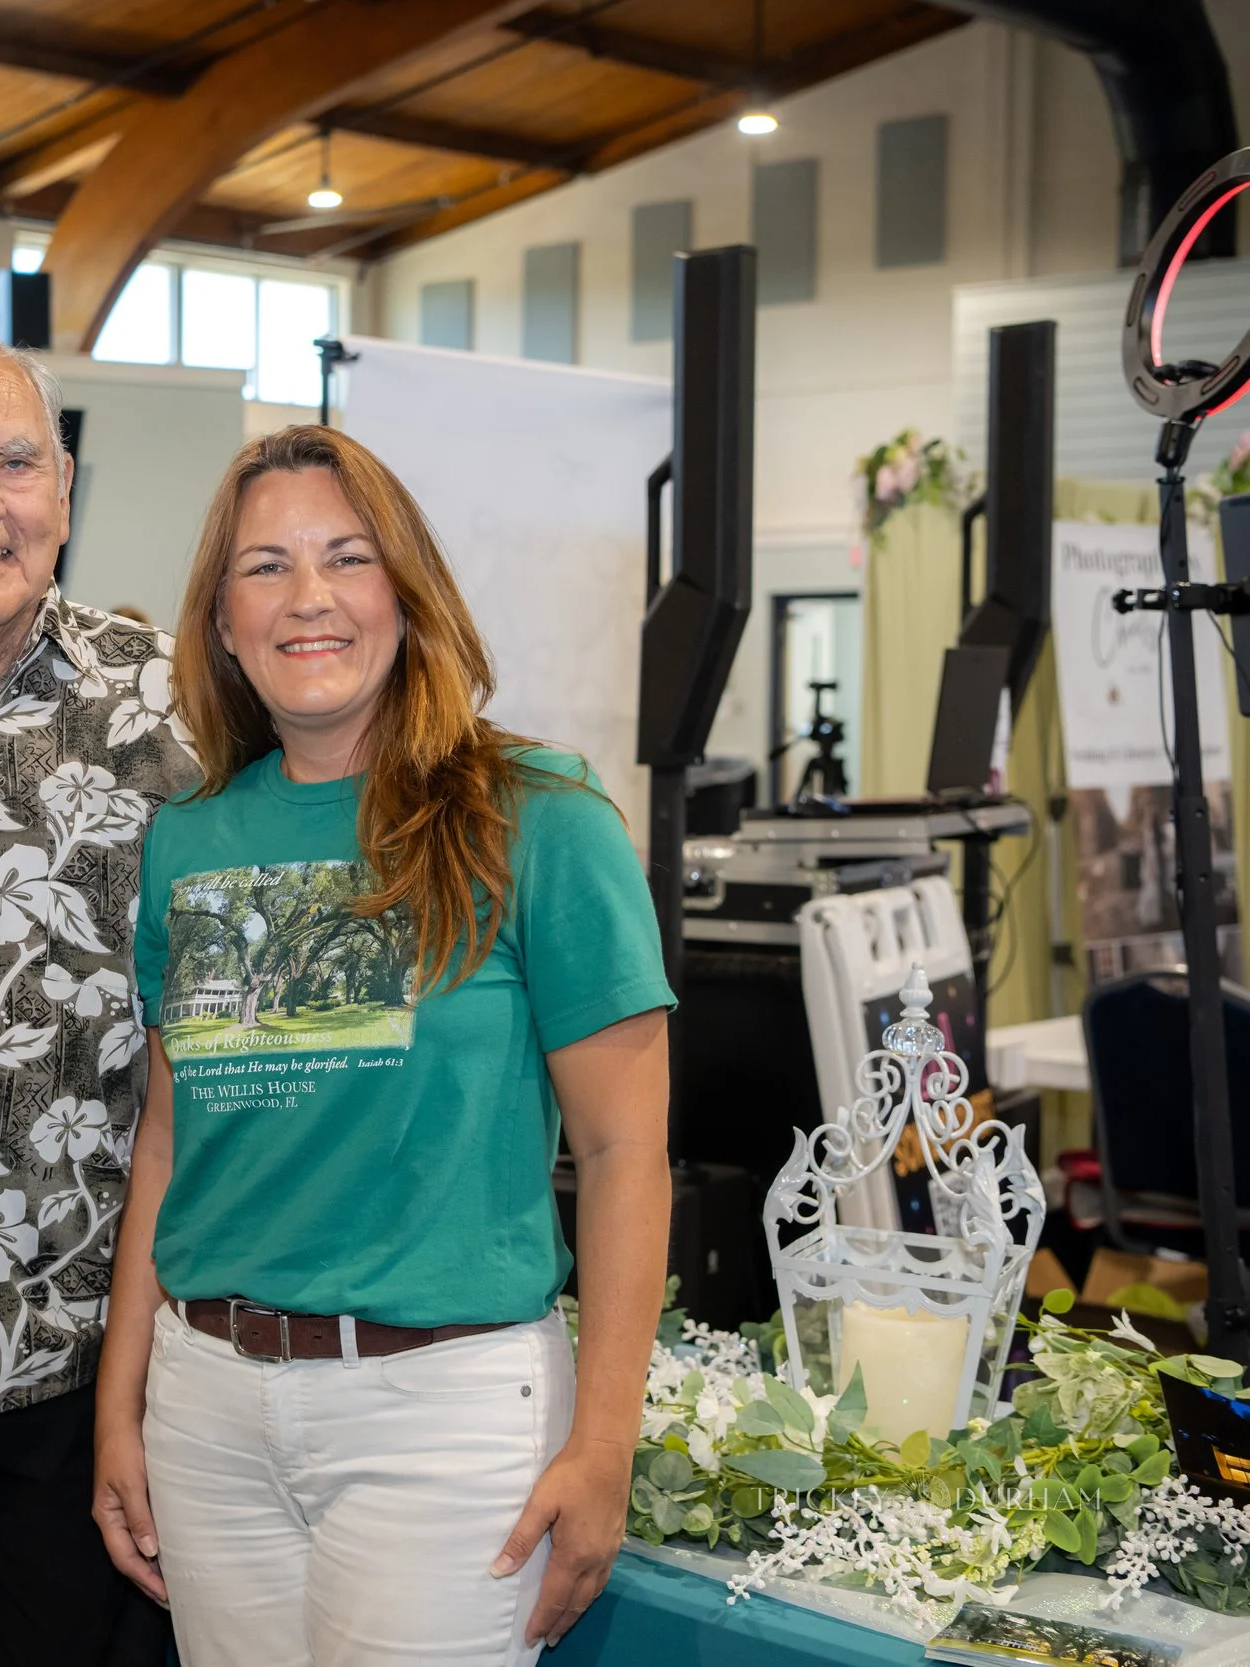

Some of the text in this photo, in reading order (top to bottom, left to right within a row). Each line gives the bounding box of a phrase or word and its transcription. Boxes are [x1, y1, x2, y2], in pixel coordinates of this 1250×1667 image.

[221, 876, 235, 889] be
[239, 872, 285, 887] called
[170, 1029, 333, 1054] Oaks of Righteousness
[199, 1063, 223, 1077] Lord
[224, 1062, 246, 1074] that
[247, 1060, 263, 1073] He
[265, 1063, 289, 1075] may
[291, 1058, 303, 1070] be
[304, 1056, 349, 1074] glorified.
[358, 1058, 404, 1068] Isaiah 61:3
[191, 1081, 317, 1100] THE WILLIS HOUSE
[206, 1096, 298, 1114] GREENWOOD, FL
